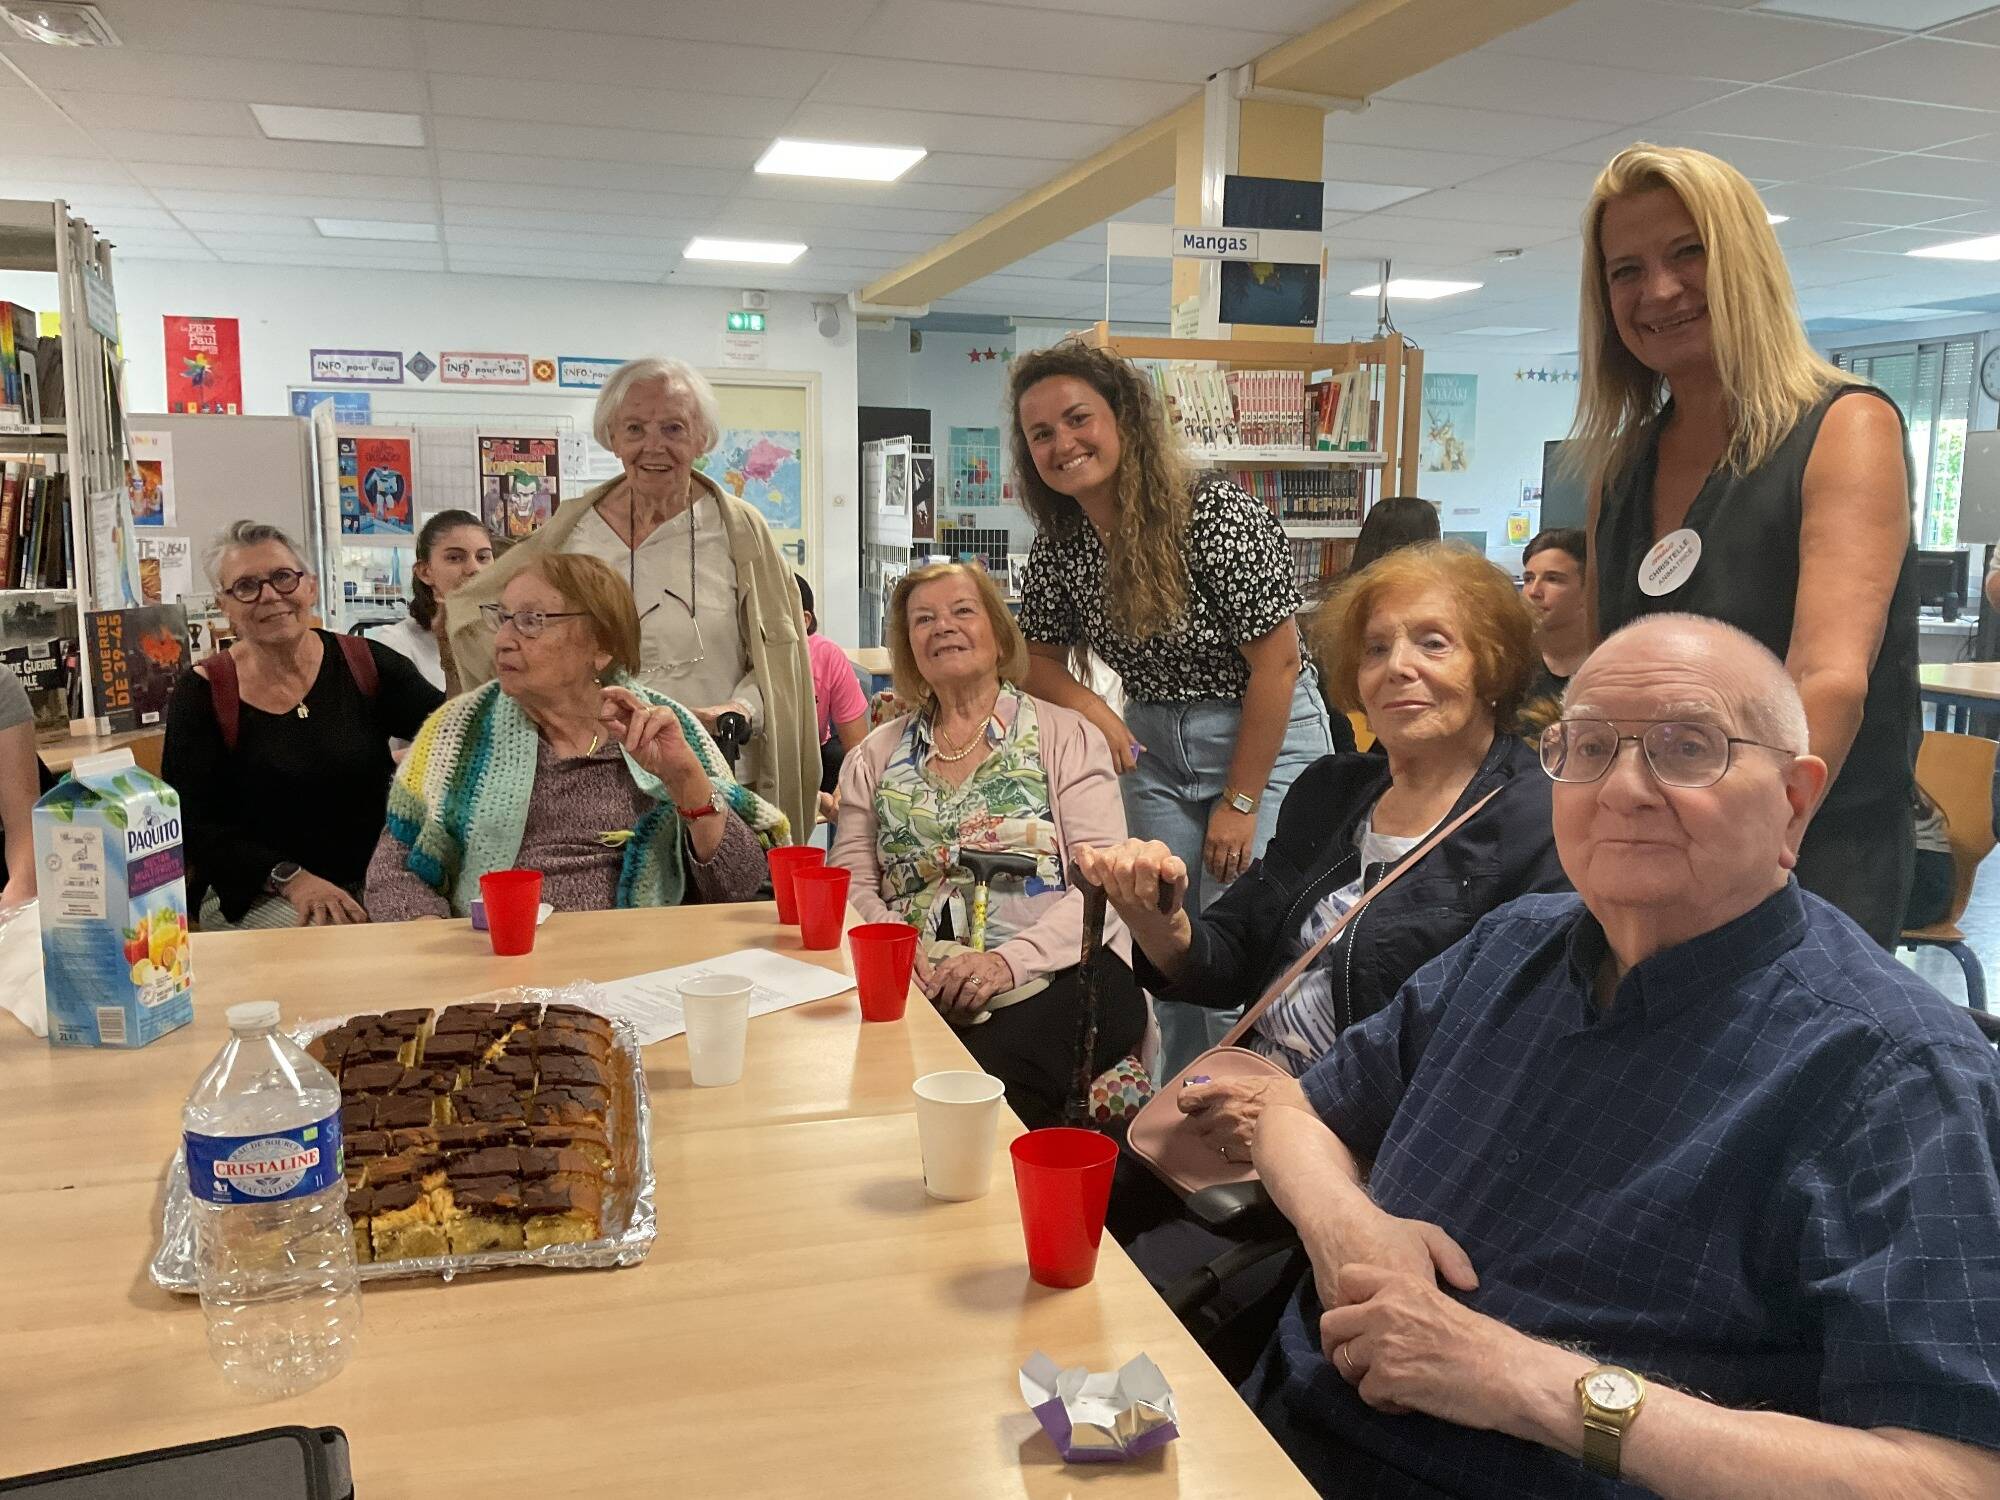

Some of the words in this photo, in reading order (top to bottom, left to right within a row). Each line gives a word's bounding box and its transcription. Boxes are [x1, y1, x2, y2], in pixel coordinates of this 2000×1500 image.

[1183, 234, 1248, 254] Mangas
[188, 323, 217, 333] PRIX
[189, 334, 218, 346] Paul
[346, 365, 370, 373] pour
[475, 367, 498, 376] pour
[1648, 538, 1690, 582] CHRISTELLE
[96, 615, 114, 682] GUERRE
[109, 614, 127, 673] 39-45
[23, 658, 57, 674] GUERRE
[105, 686, 117, 708] LA
[115, 679, 130, 706] DE
[127, 818, 180, 853] PAQUITO
[264, 1139, 301, 1151] SOURCE
[215, 1153, 318, 1176] CRISTALINE
